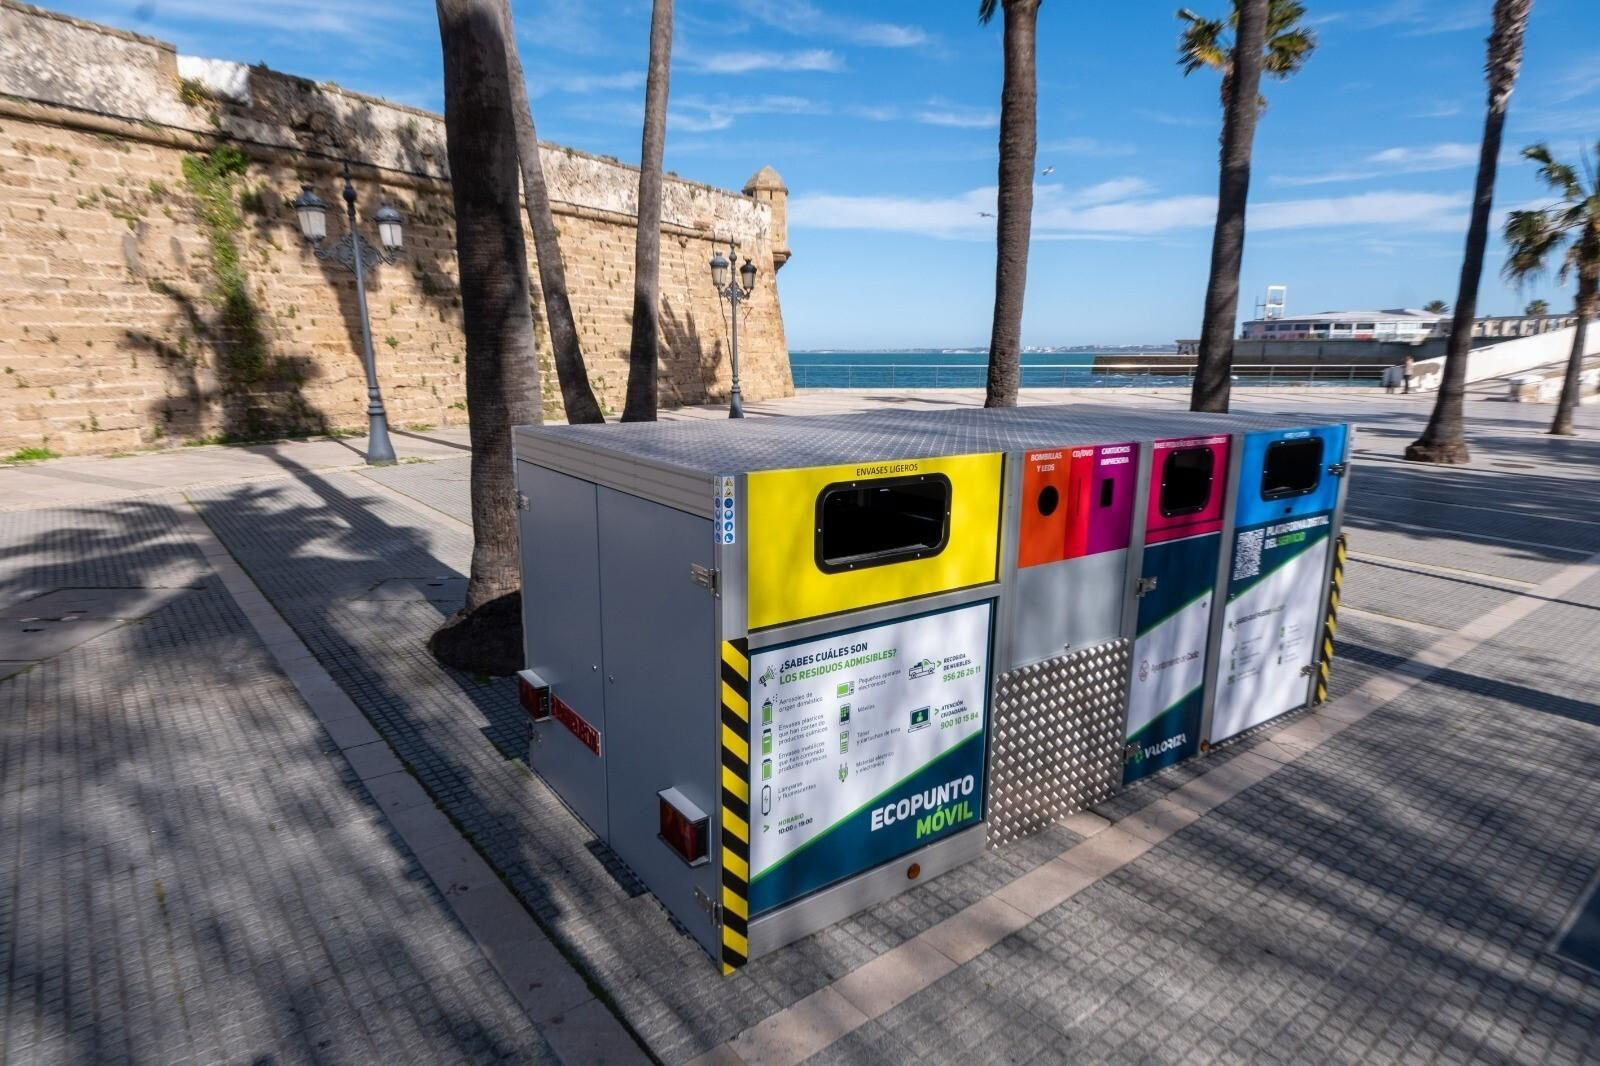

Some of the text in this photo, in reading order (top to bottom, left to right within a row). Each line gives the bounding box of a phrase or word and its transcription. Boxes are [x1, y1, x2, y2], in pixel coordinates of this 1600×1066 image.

[1030, 452, 1062, 461] BOMBILLAS
[1072, 449, 1093, 458] CD/DVD
[1101, 446, 1130, 455] CARTUCHOS
[857, 463, 918, 476] ENVASES LIGEROS
[1041, 464, 1055, 472] LEDS
[779, 641, 868, 674] ¿SABES CUÁLES SON
[943, 653, 966, 663] RECOGIDA
[779, 648, 897, 685] LOS RESIDUOS ADMISIBLES?
[943, 673, 956, 682] 956
[956, 670, 965, 679] 26
[975, 665, 981, 674] 11
[941, 700, 964, 710] ATENCIÓN
[940, 720, 954, 730] 900
[955, 716, 962, 725] 10
[870, 774, 975, 832] ECOPUNTO
[778, 813, 804, 826] HORARIO
[915, 800, 974, 839] MÓVIL
